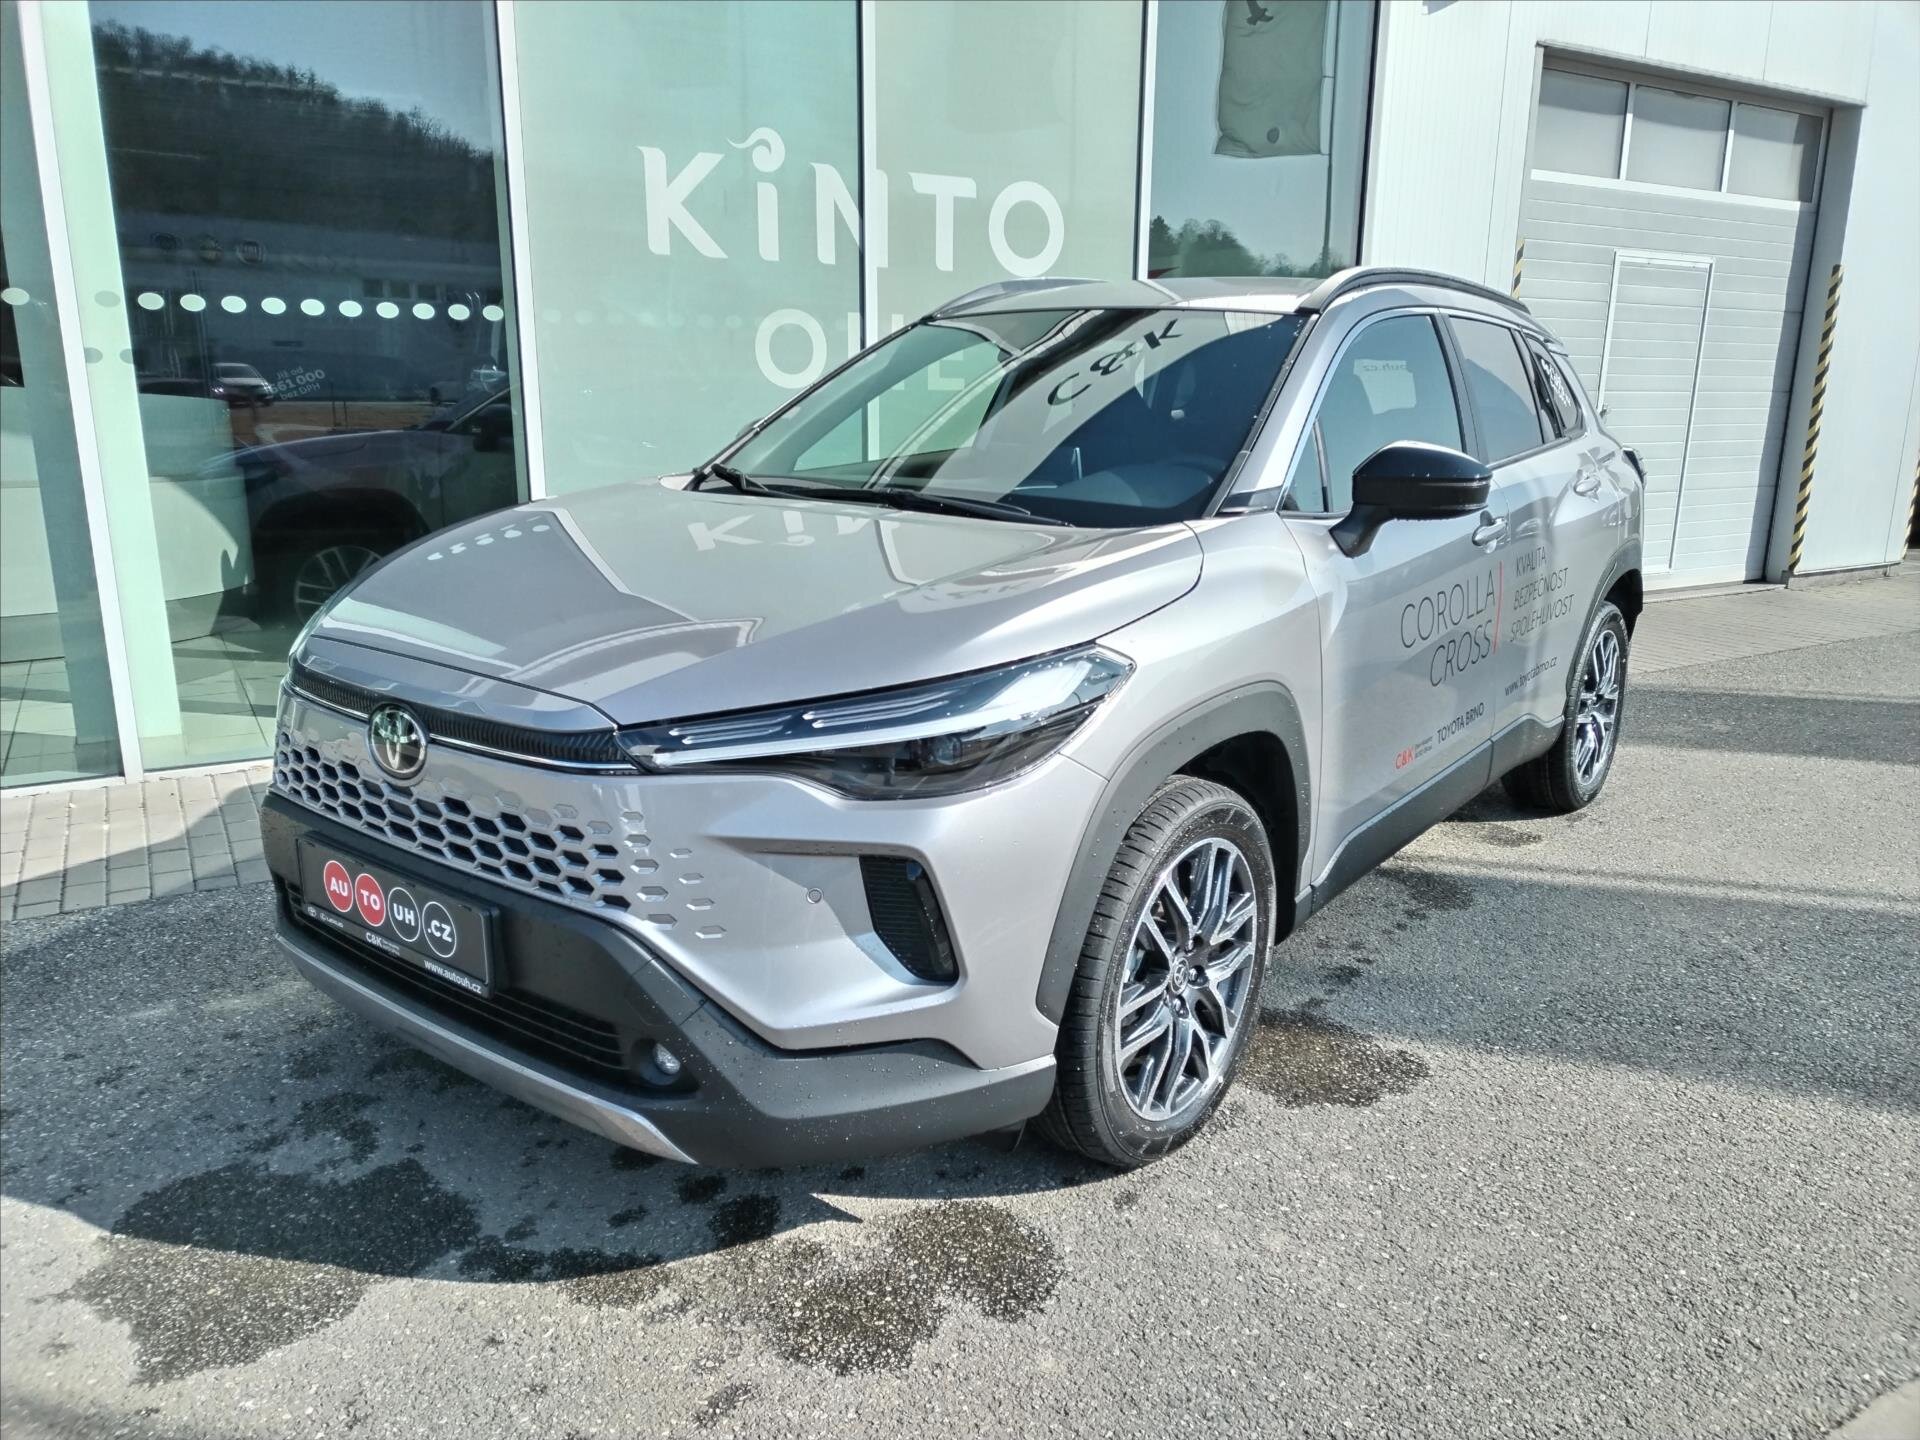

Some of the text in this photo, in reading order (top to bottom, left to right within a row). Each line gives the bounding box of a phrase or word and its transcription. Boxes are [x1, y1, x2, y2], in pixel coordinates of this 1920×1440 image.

[1516, 546, 1547, 577] KVALITA
[1401, 569, 1496, 649] COROLLA
[1513, 567, 1569, 611] BEZPEČNOST
[1510, 594, 1575, 642] SPOLEHLIVOST
[1430, 619, 1493, 687] CROSS
[1437, 715, 1465, 744] TOYOTA
[1465, 702, 1485, 726] BRNO
[423, 959, 482, 994] www.autouh.cz
